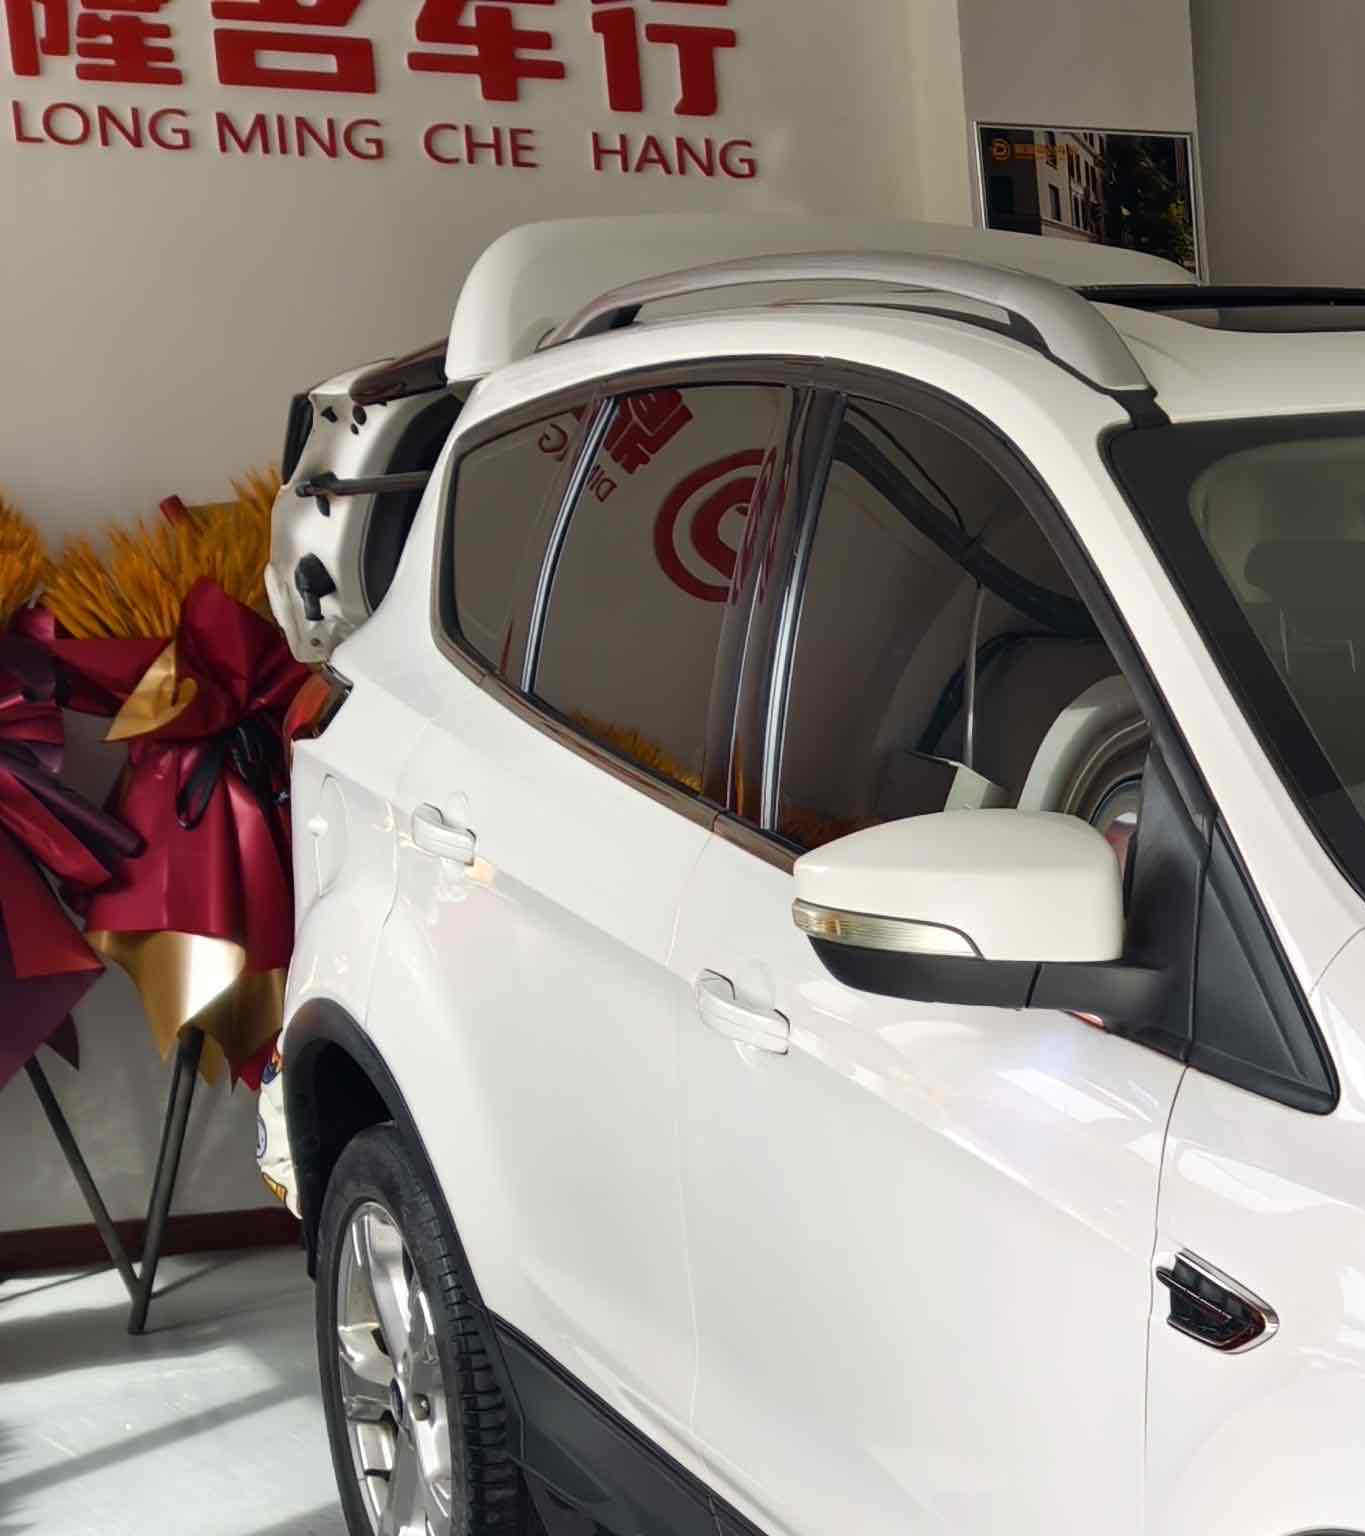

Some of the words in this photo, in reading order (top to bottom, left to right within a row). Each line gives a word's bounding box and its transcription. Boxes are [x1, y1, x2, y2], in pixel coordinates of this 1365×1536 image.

[12, 100, 193, 151] LONG
[216, 111, 386, 161] MING
[422, 123, 539, 169] CHE
[591, 131, 758, 180] HANG
